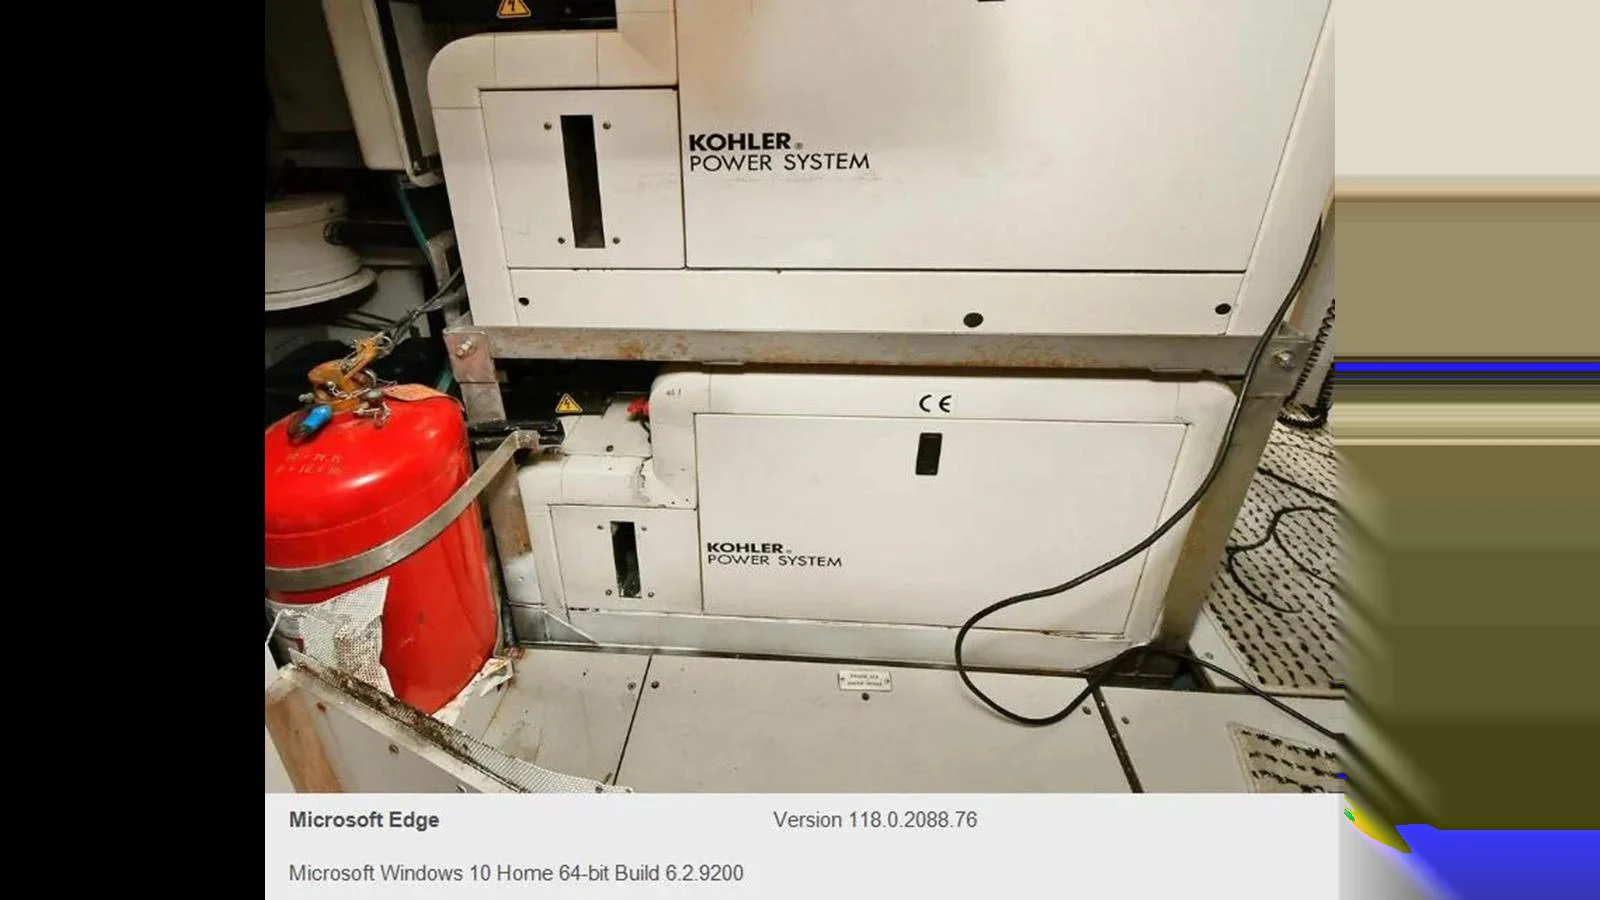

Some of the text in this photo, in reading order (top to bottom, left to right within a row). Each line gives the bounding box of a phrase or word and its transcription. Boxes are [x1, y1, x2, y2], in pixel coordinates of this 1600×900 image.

[689, 152, 870, 172] POWER SYSTEM
[918, 394, 952, 414] CE
[707, 554, 842, 567] POWER SYSTEM
